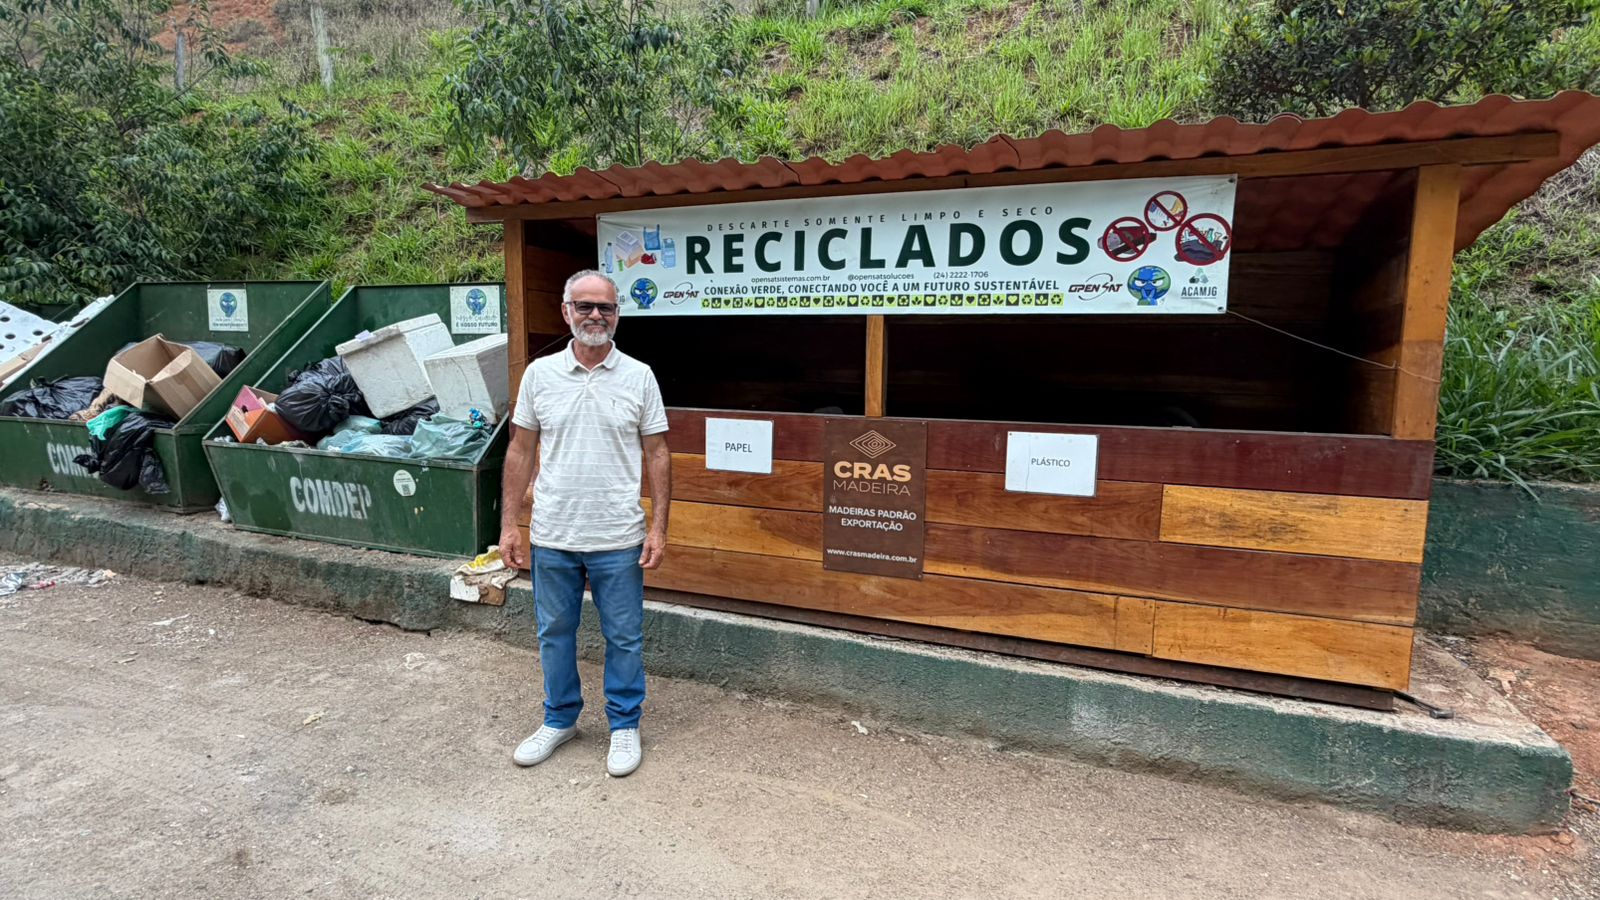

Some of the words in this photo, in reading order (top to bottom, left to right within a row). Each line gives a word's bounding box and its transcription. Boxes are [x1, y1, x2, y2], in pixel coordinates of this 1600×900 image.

[707, 219, 790, 232] DESCARTE
[804, 214, 886, 226] SOMENTE
[902, 210, 961, 222] LIMPO
[978, 209, 984, 218] E
[1002, 206, 1053, 217] SECO
[685, 217, 1092, 275] RECICLADOS
[751, 274, 831, 283] opensatsistemas.com.br
[847, 272, 914, 282] @opensatsolucoes
[704, 283, 748, 295] CONEXÃO
[751, 285, 785, 295] VERDE,
[788, 283, 857, 294] CONECTANDO
[860, 280, 889, 292] VOCÊ
[892, 283, 899, 292] A
[903, 282, 920, 292] UM
[924, 281, 970, 292] FUTURO
[974, 278, 1059, 291] SUSTENTÁVEL
[1181, 286, 1218, 297] ACAMJG
[724, 442, 753, 453] PAPEL
[1030, 456, 1071, 468] PLÁSTICO
[833, 460, 912, 483] CRAS
[833, 479, 911, 496] MADEIRA
[289, 476, 372, 519] COMDEP
[828, 505, 876, 517] MADEIRAS
[877, 508, 917, 521] PADRÃO
[841, 517, 904, 532] EXPORTAÇÃO
[826, 548, 918, 563] www.crasmadeira.com.br
